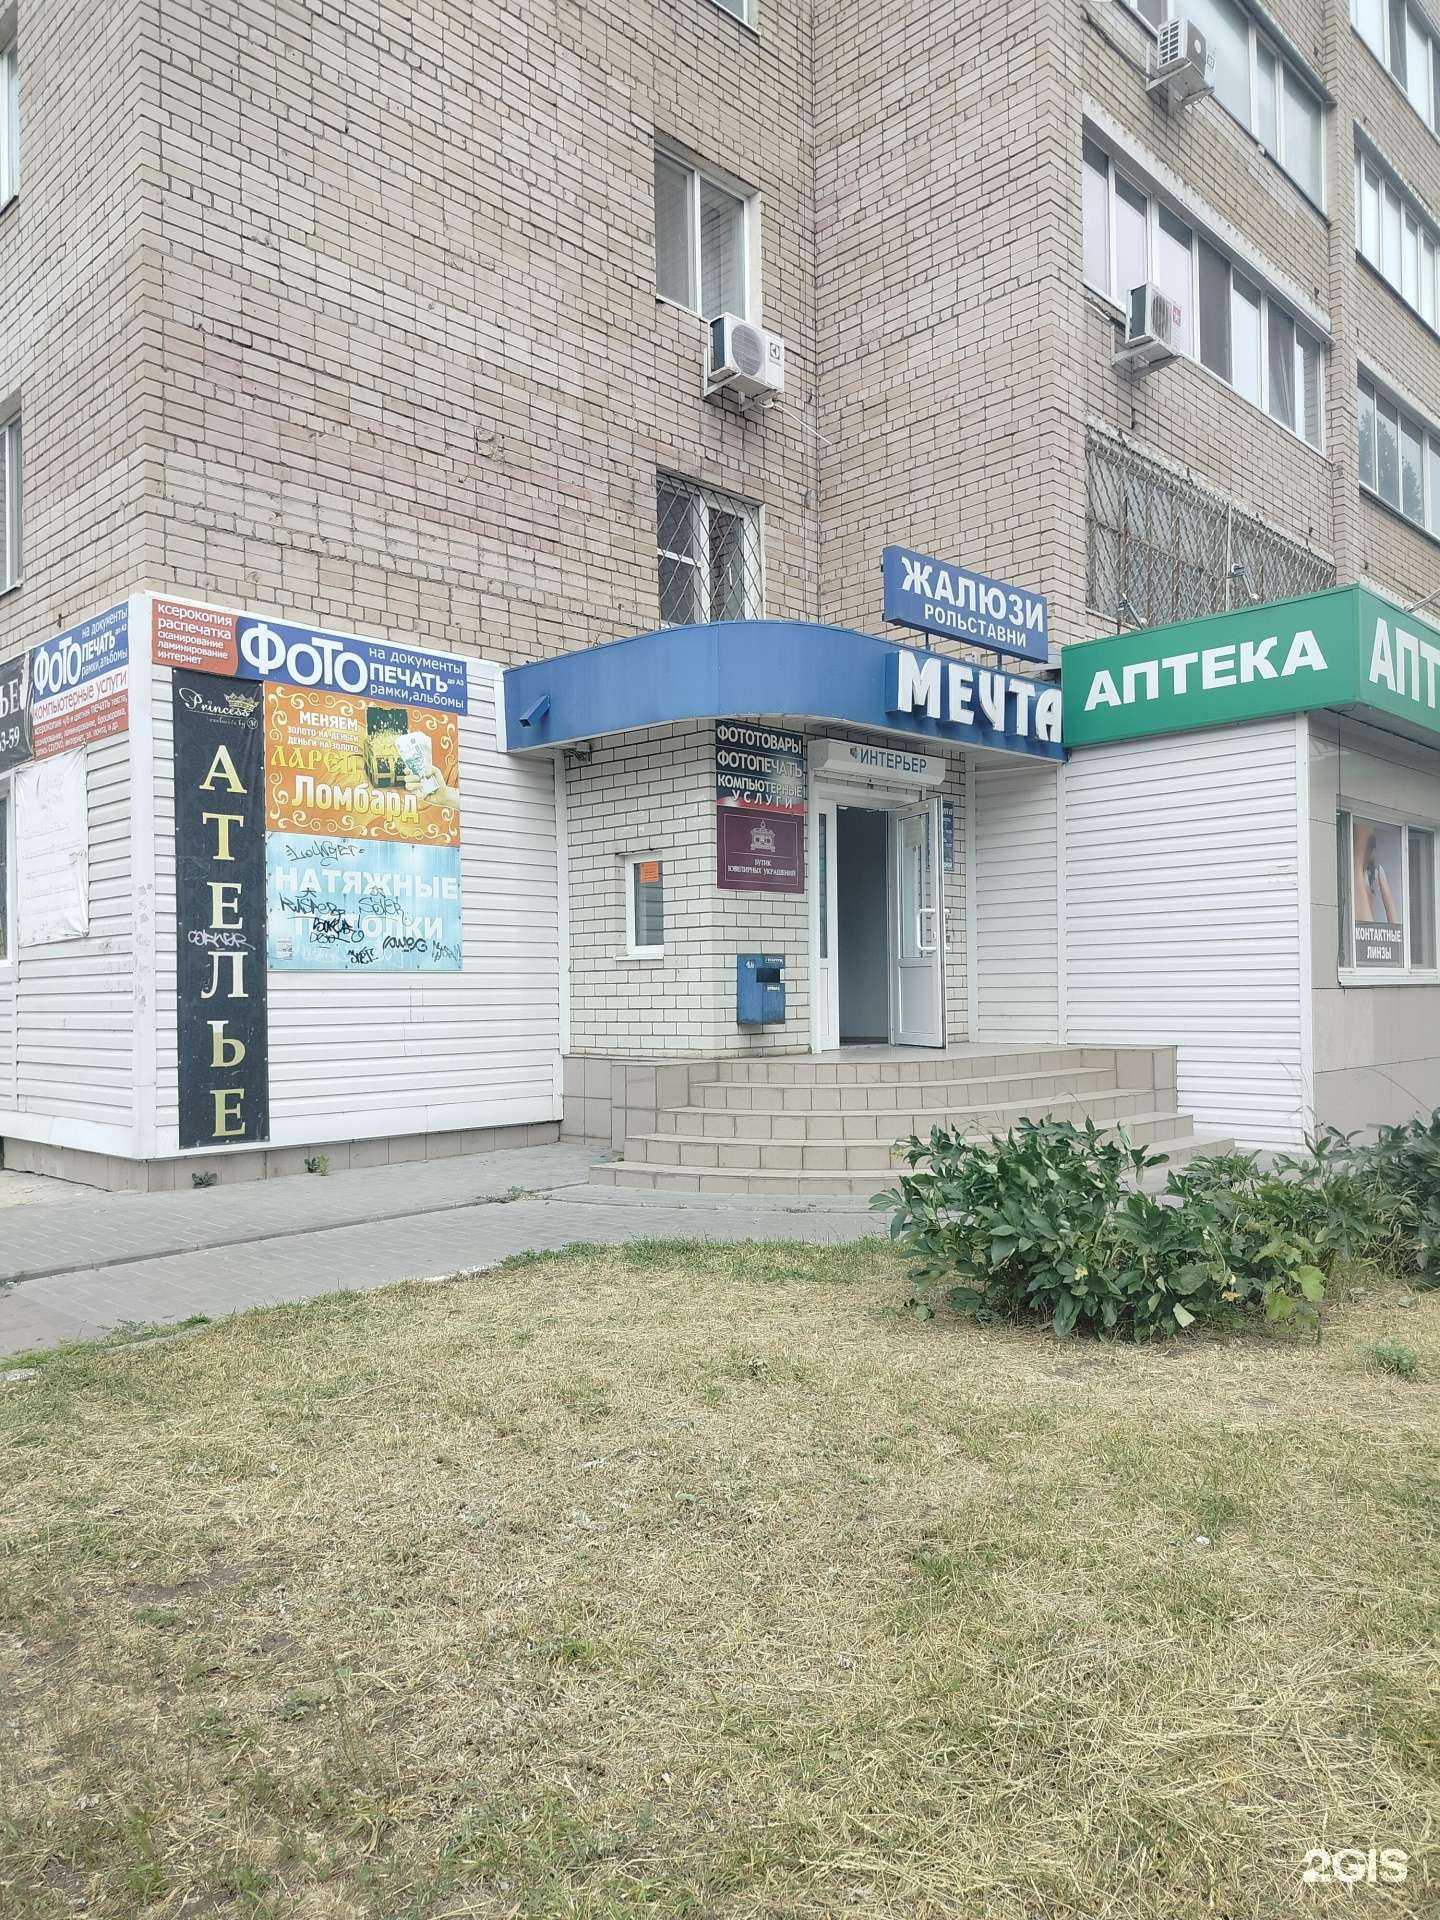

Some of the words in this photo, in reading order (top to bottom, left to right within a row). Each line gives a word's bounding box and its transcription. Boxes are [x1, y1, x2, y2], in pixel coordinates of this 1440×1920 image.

[901, 556, 1044, 633] ЖАЛЮЗИ
[157, 603, 233, 627] ксерокопия
[925, 603, 1027, 648] РОЛЬСТАВНИ
[157, 631, 225, 649] сканирование
[158, 617, 232, 640] распечатка
[81, 630, 116, 663] ПЕЧАТЬ
[158, 641, 229, 660] ламинирование
[158, 651, 202, 665] интернет
[240, 622, 369, 694] ФОТО
[33, 637, 82, 696] ФОТО
[368, 647, 386, 660] на
[390, 651, 463, 675] документы
[1084, 629, 1329, 712] АПТЕКА
[97, 671, 128, 696] услуги
[369, 662, 449, 693] ПЕЧАТЬ
[179, 692, 251, 717] Princess
[897, 650, 1063, 744] МЕЧТА
[299, 710, 358, 732] МЕНЯЕМ
[0, 726, 20, 753] 3-59
[287, 726, 317, 737] ЗОЛОТО
[319, 730, 329, 739] НА
[331, 731, 359, 743] ДЕНЬГИ
[287, 736, 318, 748] ДЕНЬГИ
[320, 740, 329, 749] НА
[331, 742, 359, 754] ЗОЛОТО
[717, 725, 803, 755] ФОТОТОВАРЫ
[717, 749, 803, 779] ФОТОПЕЧАТЬ
[860, 748, 928, 774] ИНТЕРЬЕР
[717, 774, 803, 798] КОМПЬЮТЕРНЫЕ
[291, 774, 420, 824] Ломбард
[731, 789, 793, 809] УСЛУГИ
[727, 865, 762, 874] ЮВЕЛИРНЫХ
[754, 858, 772, 867] БУТИК
[274, 866, 458, 900] НАТЯЖНЫЕ
[199, 744, 260, 1138] АТЕЛЬЕ
[1355, 927, 1403, 943] КОНТАКТНЫЕ
[1366, 946, 1392, 960] ЛИНЗЫ
